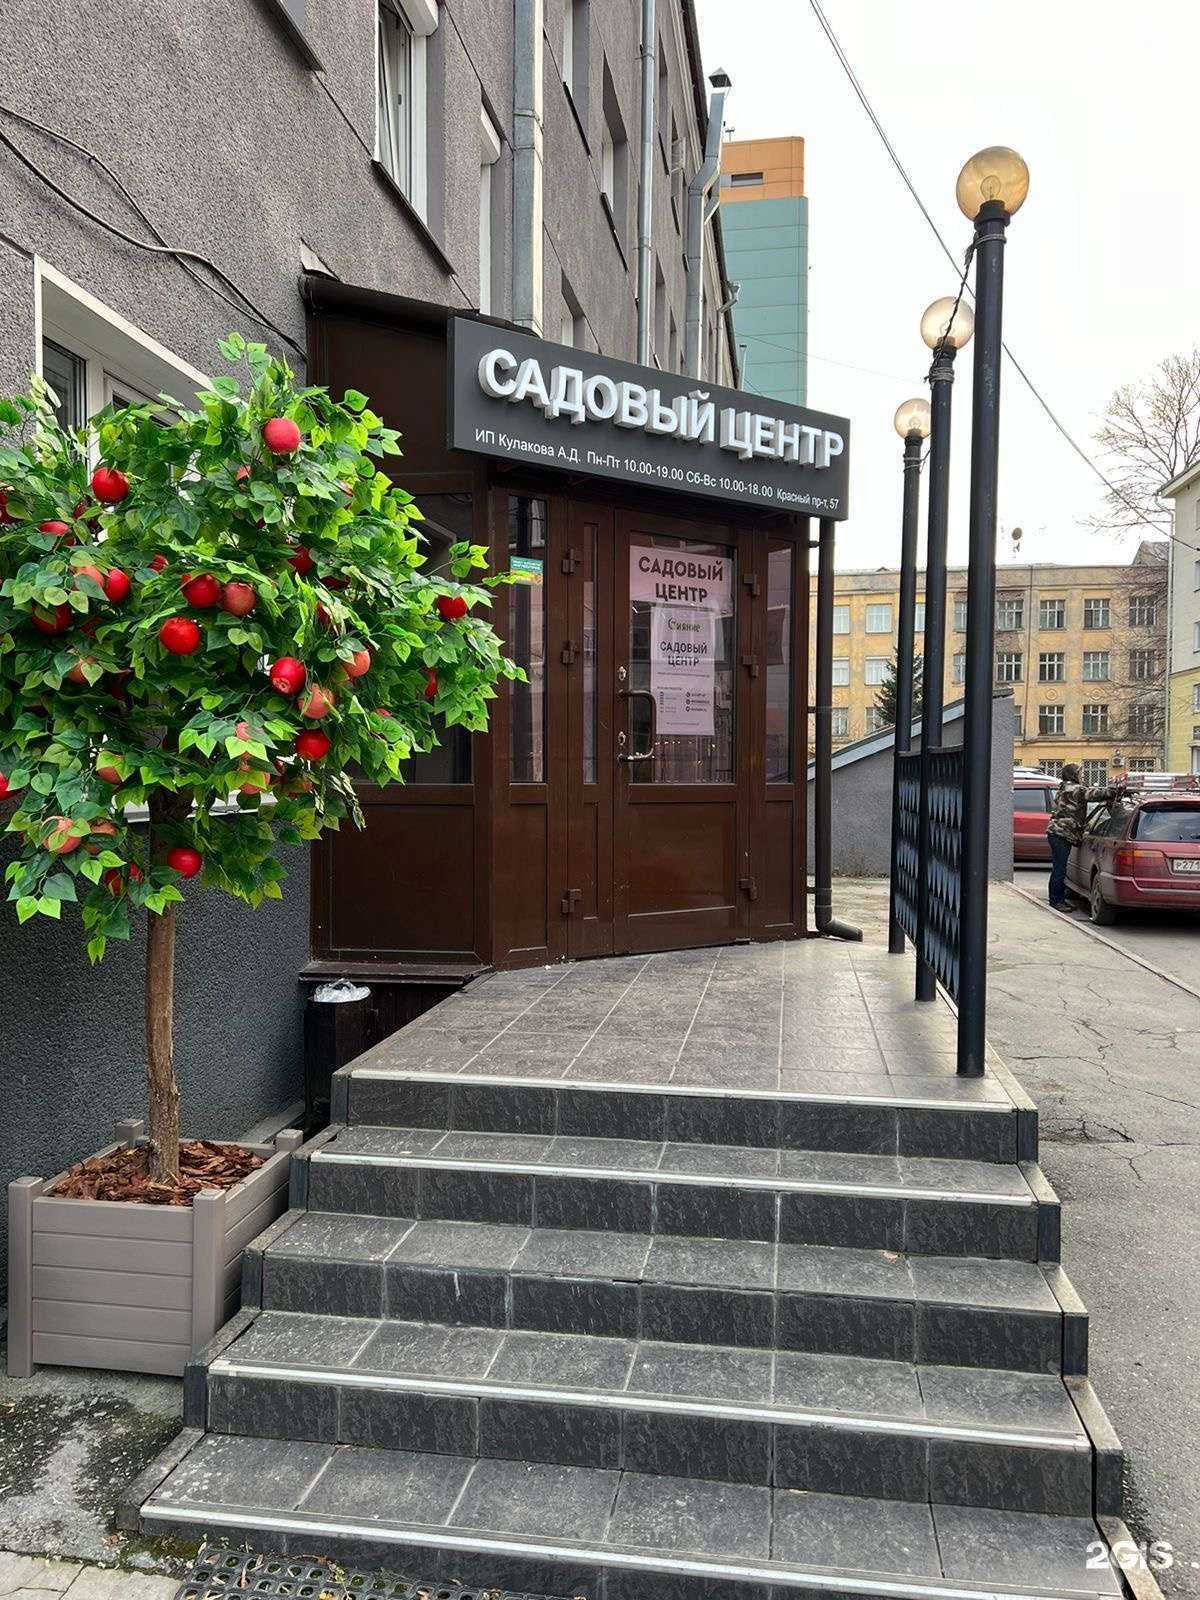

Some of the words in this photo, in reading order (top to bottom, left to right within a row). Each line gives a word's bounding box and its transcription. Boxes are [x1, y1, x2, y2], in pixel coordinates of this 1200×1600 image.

[477, 348, 715, 444] САДОВЫЙ
[720, 407, 845, 469] ЦЕНТР
[475, 428, 495, 445] ИП
[498, 433, 555, 457] Кулакова
[557, 446, 581, 464] А.Д.
[587, 451, 620, 469] Пн-Пт
[624, 459, 684, 481] 10.00-19.00
[686, 470, 717, 487] Сб-Вс
[719, 478, 773, 498] 10.00-18.00
[776, 488, 811, 505] Красный
[638, 555, 723, 582] САДОВЫЙ
[655, 582, 708, 603] ЦЕНТР
[659, 640, 707, 654] САДОВЫЙ
[667, 655, 700, 667] ЦЕНТР
